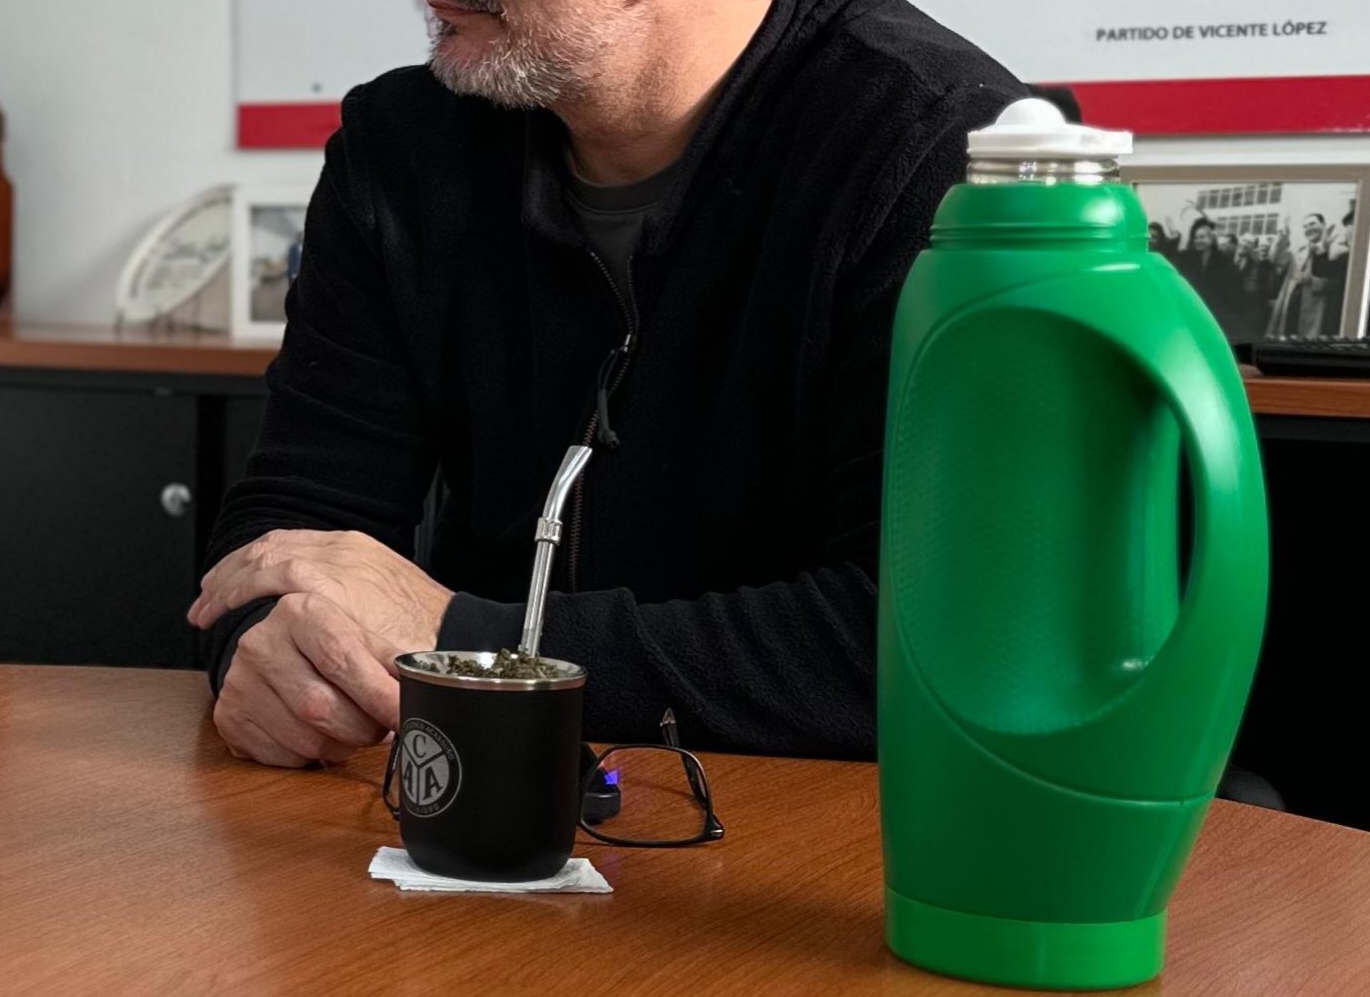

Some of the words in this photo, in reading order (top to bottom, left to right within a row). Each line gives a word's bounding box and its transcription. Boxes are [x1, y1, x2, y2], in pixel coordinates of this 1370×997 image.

[1095, 25, 1169, 42] PARTIDO
[1172, 24, 1195, 40] DE
[1199, 22, 1268, 38] VICENTE
[1272, 19, 1328, 37] LÓPEZ
